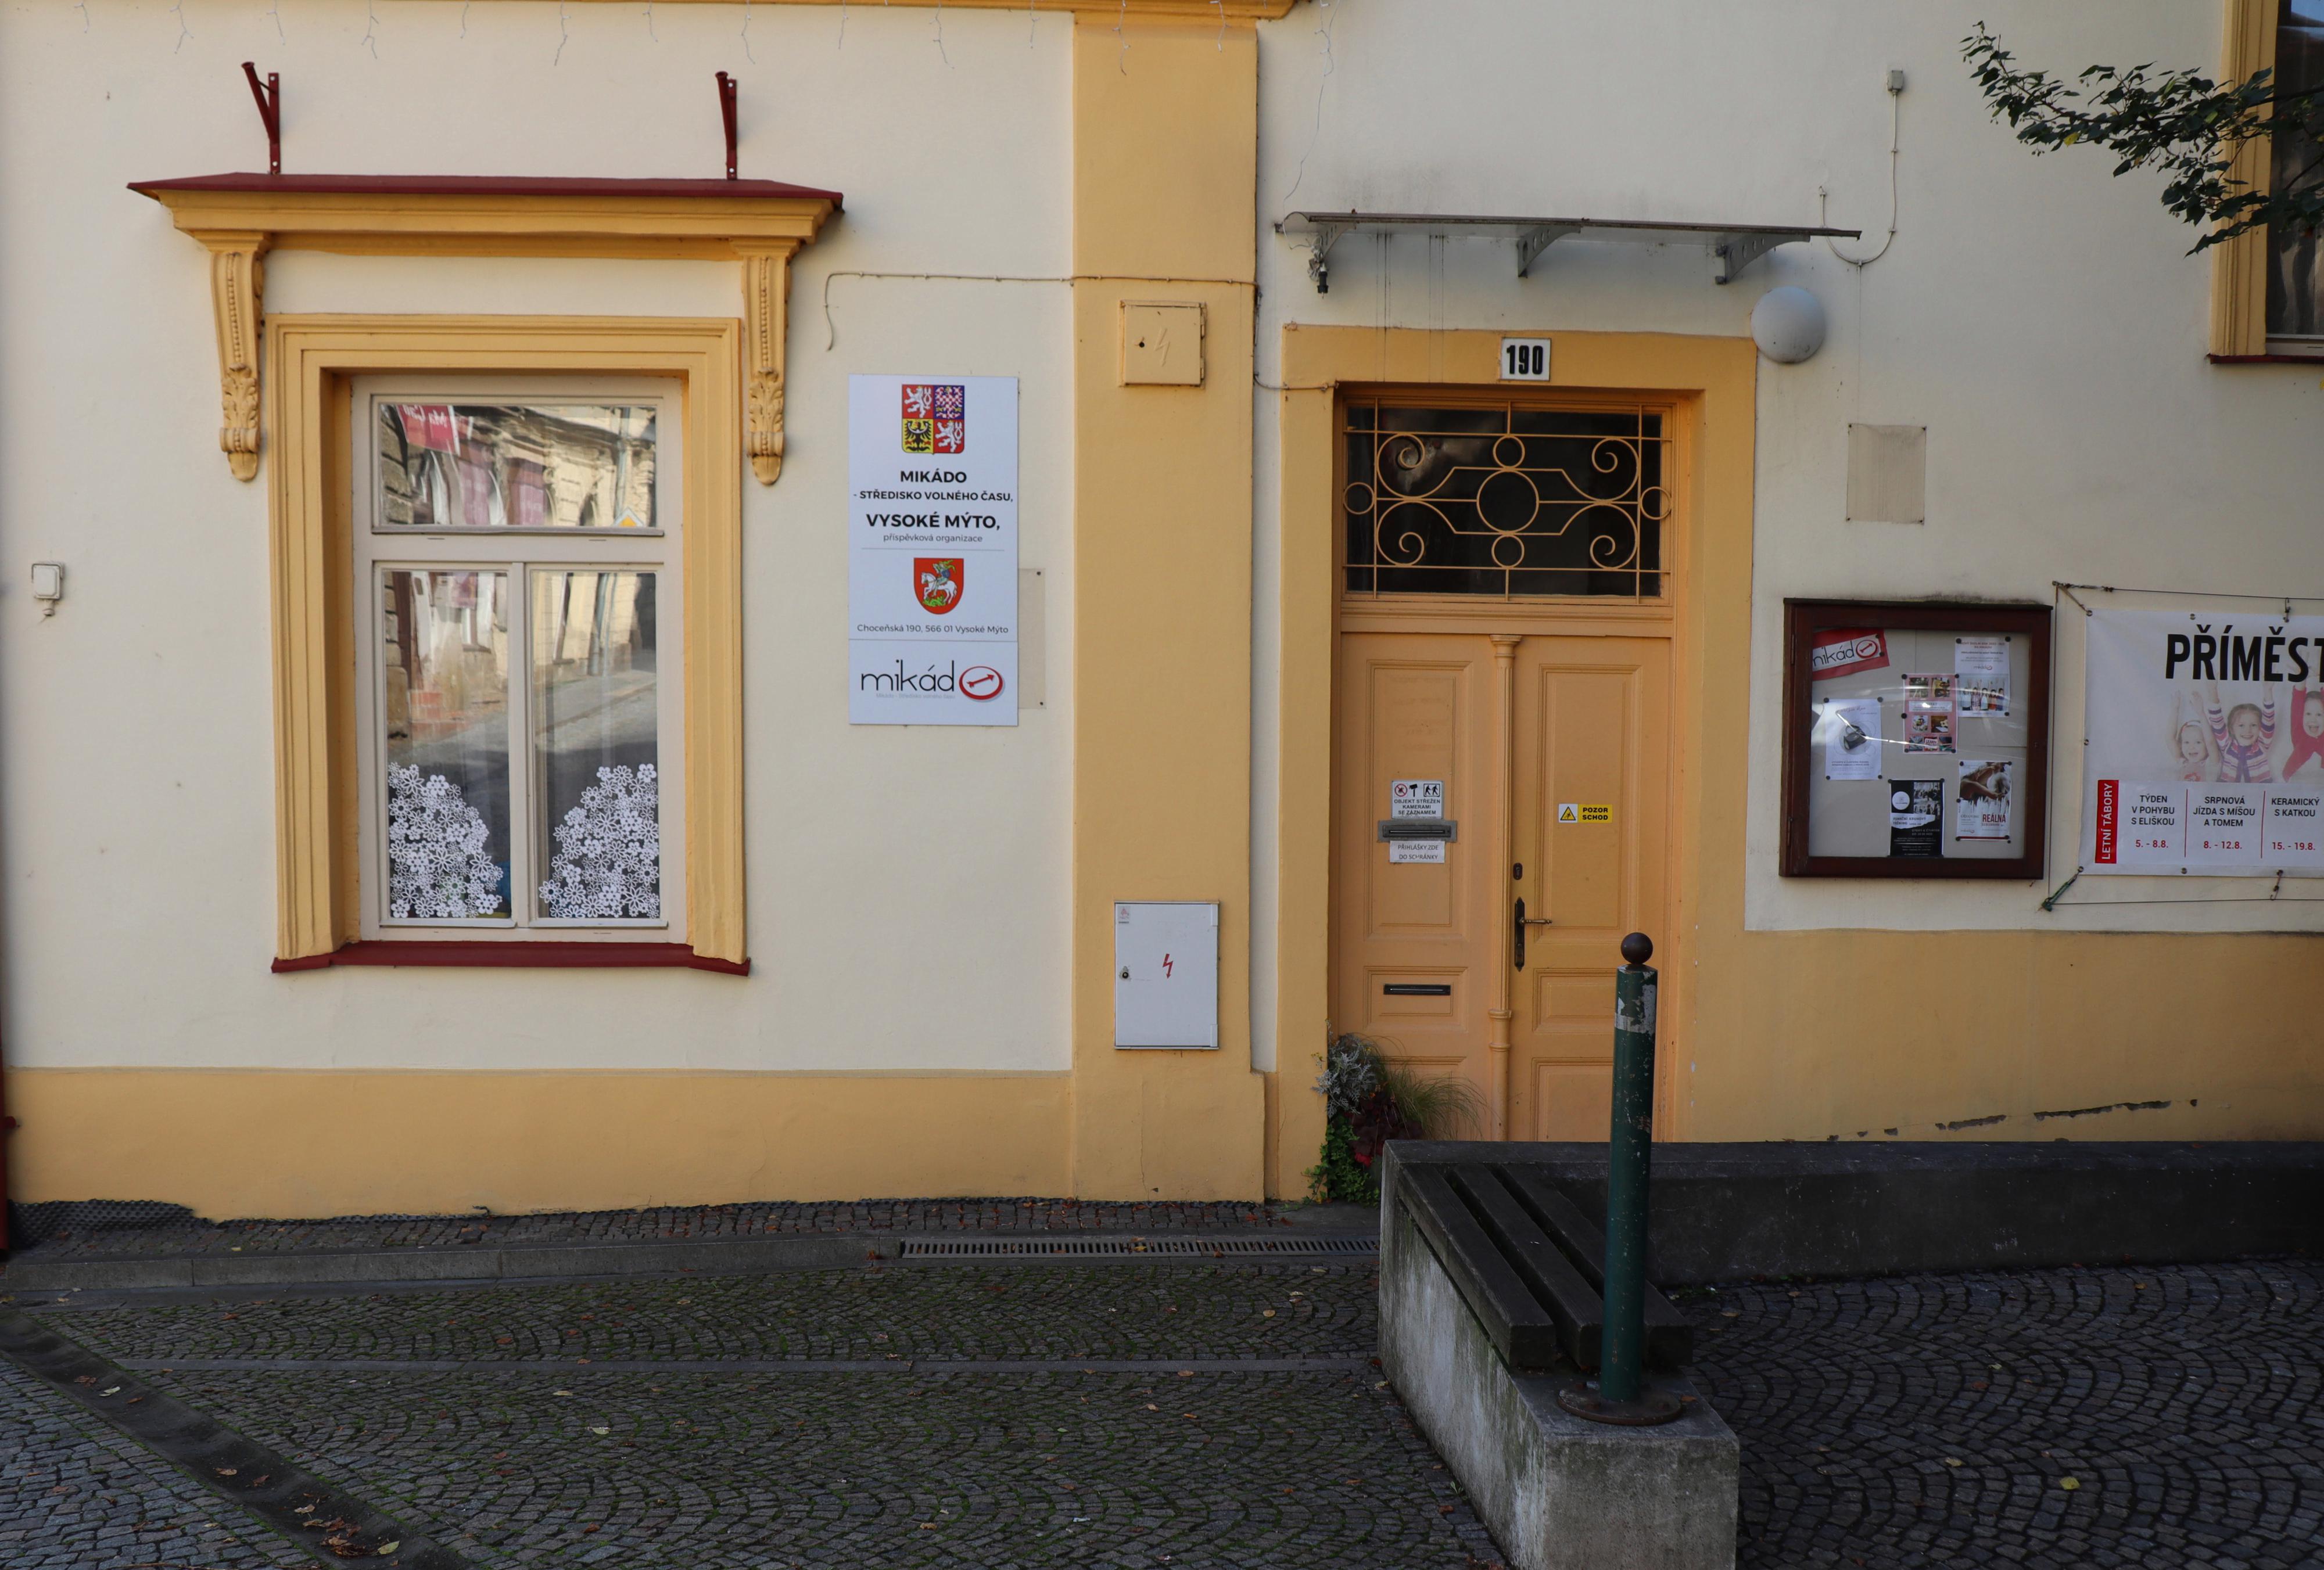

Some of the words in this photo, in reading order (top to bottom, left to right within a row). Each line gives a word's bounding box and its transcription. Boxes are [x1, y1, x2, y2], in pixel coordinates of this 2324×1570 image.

[1506, 344, 1543, 375] 190
[900, 468, 967, 483] MIKÁDO
[859, 489, 922, 500] STŘEDISKO
[924, 490, 978, 501] VOLNÉHO
[981, 491, 1013, 502] ČASU,
[866, 512, 940, 527] VYSOKÉ
[945, 512, 1000, 530] MÝTO,
[883, 533, 934, 542] příspěvková
[935, 534, 983, 543] organizace
[857, 624, 903, 632] Choceňská
[906, 625, 923, 633] 190,
[955, 626, 984, 634] Vysoké
[987, 626, 1009, 634] Mýto
[2140, 793, 2167, 803] TÝDEN
[2204, 796, 2245, 804] SRPNOVÁ
[2271, 796, 2320, 806] KERAMICKÝ
[2101, 783, 2113, 826] TÁBORY
[2140, 806, 2175, 814] POHYBU
[2193, 806, 2217, 815] JÍZDA
[2227, 806, 2255, 816] MÍŠOU
[1982, 813, 2006, 823] REÁLNÁ
[2139, 816, 2175, 825] ELIŠKOU
[2212, 818, 2243, 827] TOMEM
[2101, 828, 2111, 860] LETNÍ
[2153, 840, 2168, 848] 8.8.
[2204, 840, 2211, 849] 8.
[2221, 841, 2242, 849] 12.8.
[2272, 842, 2285, 850] 15.
[2294, 842, 2315, 850] 19.8.
